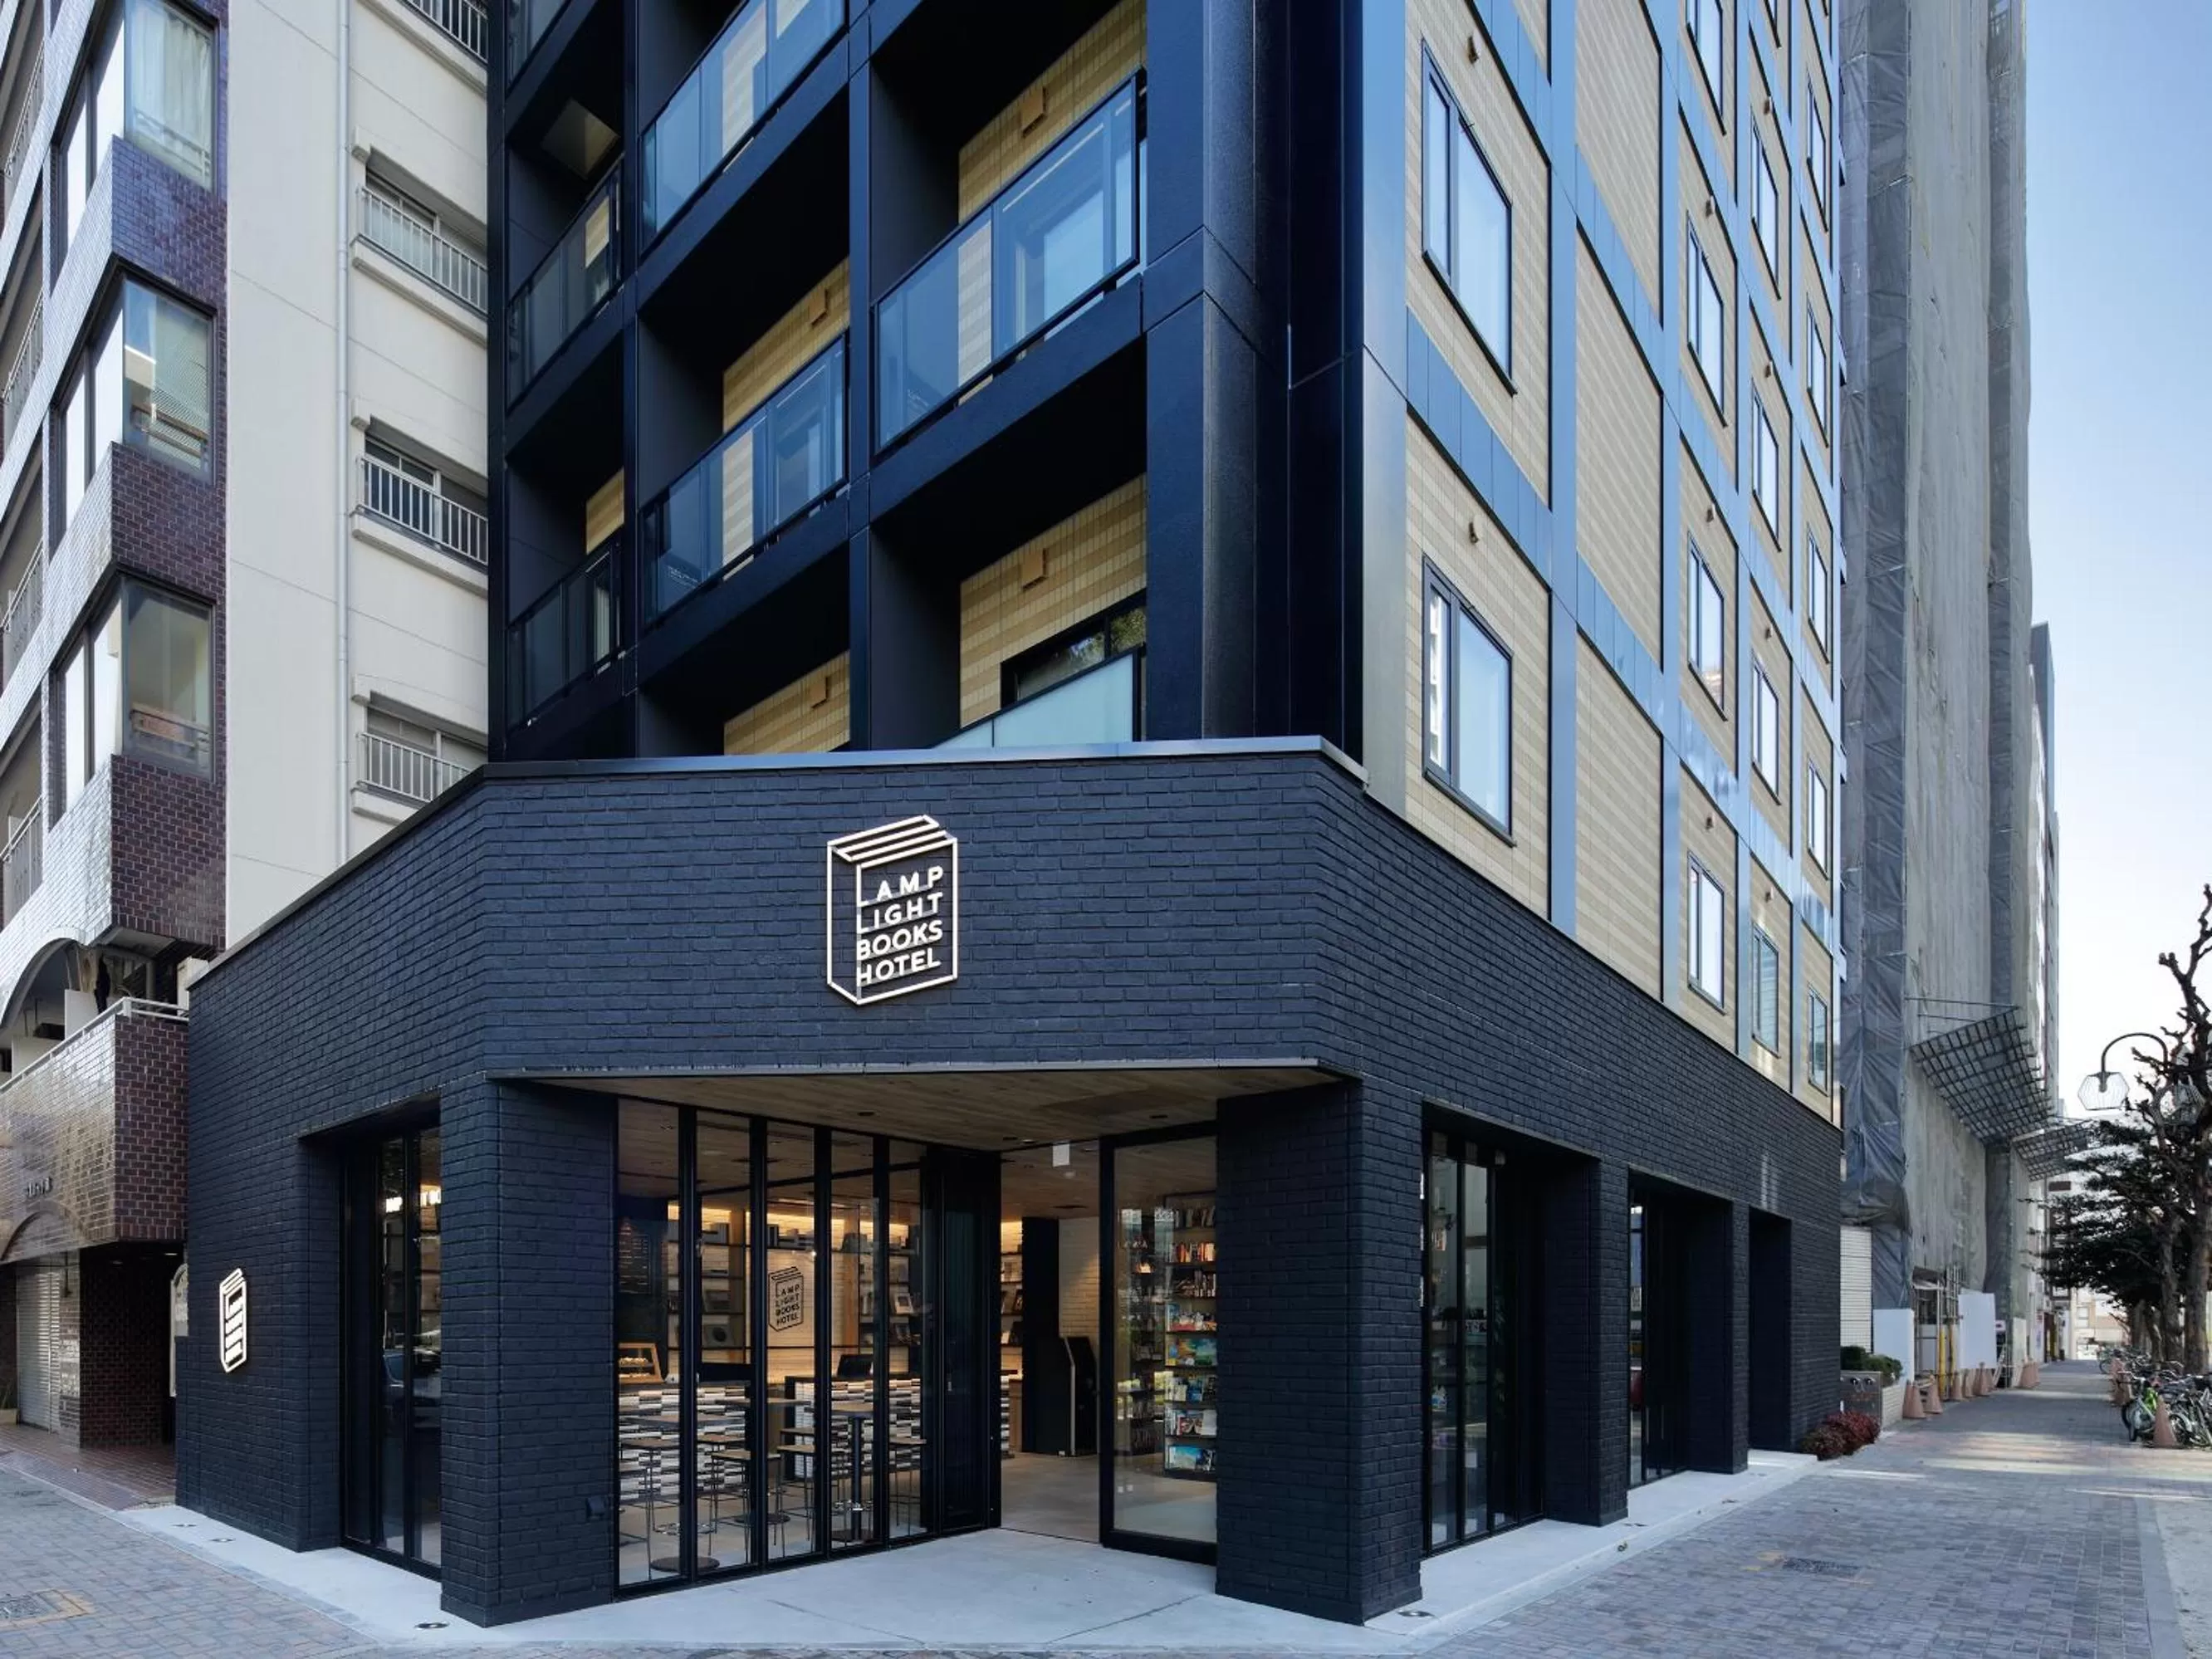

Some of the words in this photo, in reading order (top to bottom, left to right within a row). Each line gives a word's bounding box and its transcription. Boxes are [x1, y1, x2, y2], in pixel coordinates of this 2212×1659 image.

[857, 865, 944, 908] LAMP
[857, 891, 944, 934] LIGHT
[857, 920, 944, 962] BOOKS
[857, 947, 942, 987] HOTEL
